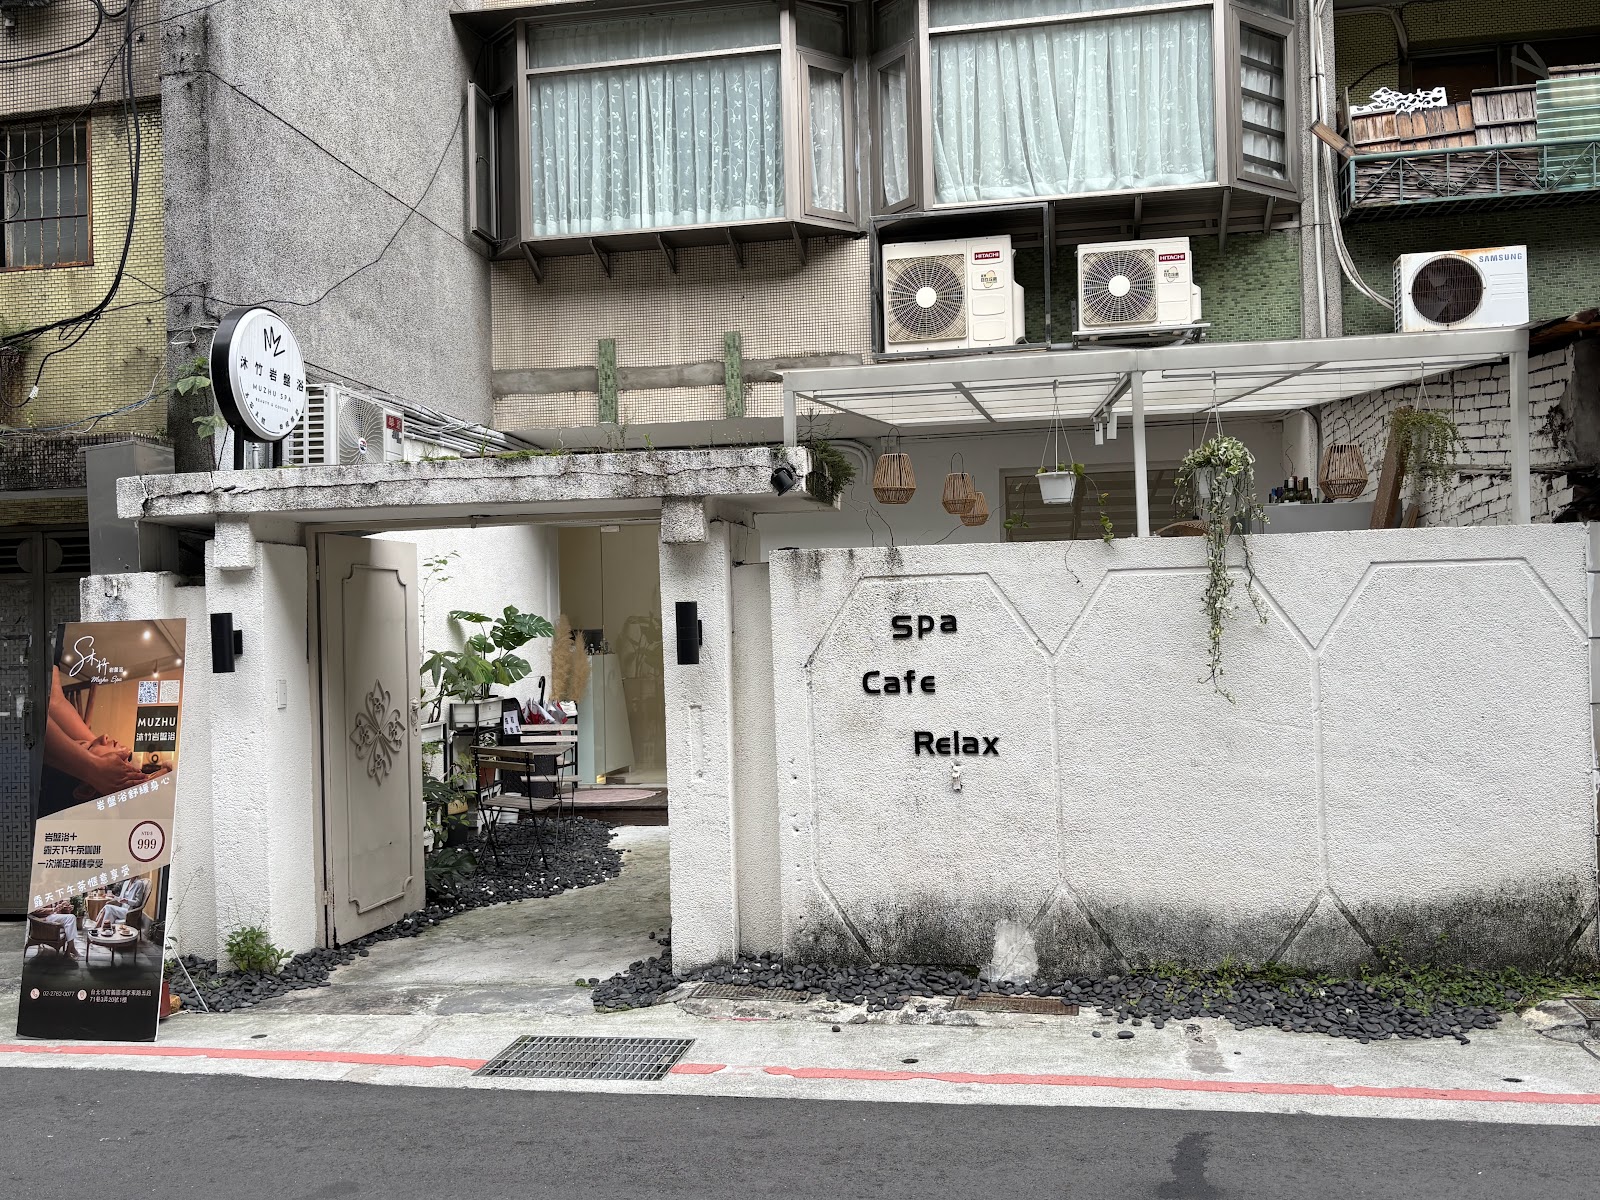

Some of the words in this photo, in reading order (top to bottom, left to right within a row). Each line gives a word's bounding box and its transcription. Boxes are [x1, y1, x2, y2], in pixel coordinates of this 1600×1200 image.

[1479, 253, 1523, 262] SAMSUNG
[240, 355, 304, 393] 沐竹岩盤浴
[252, 383, 277, 397] MUZHU
[280, 393, 292, 403] SPA
[862, 670, 936, 694] Cafe
[137, 717, 176, 727] MUZHU
[135, 731, 176, 742] 沐竹岩盤浴
[914, 731, 999, 756] Relax
[96, 777, 170, 811] 岩盤浴舒緩身心
[43, 845, 102, 855] 露天下午茶咖啡
[137, 838, 157, 850] 999
[37, 858, 104, 869] 一次滿足兩種享受
[33, 864, 130, 908] 露天下午茶愜意享受
